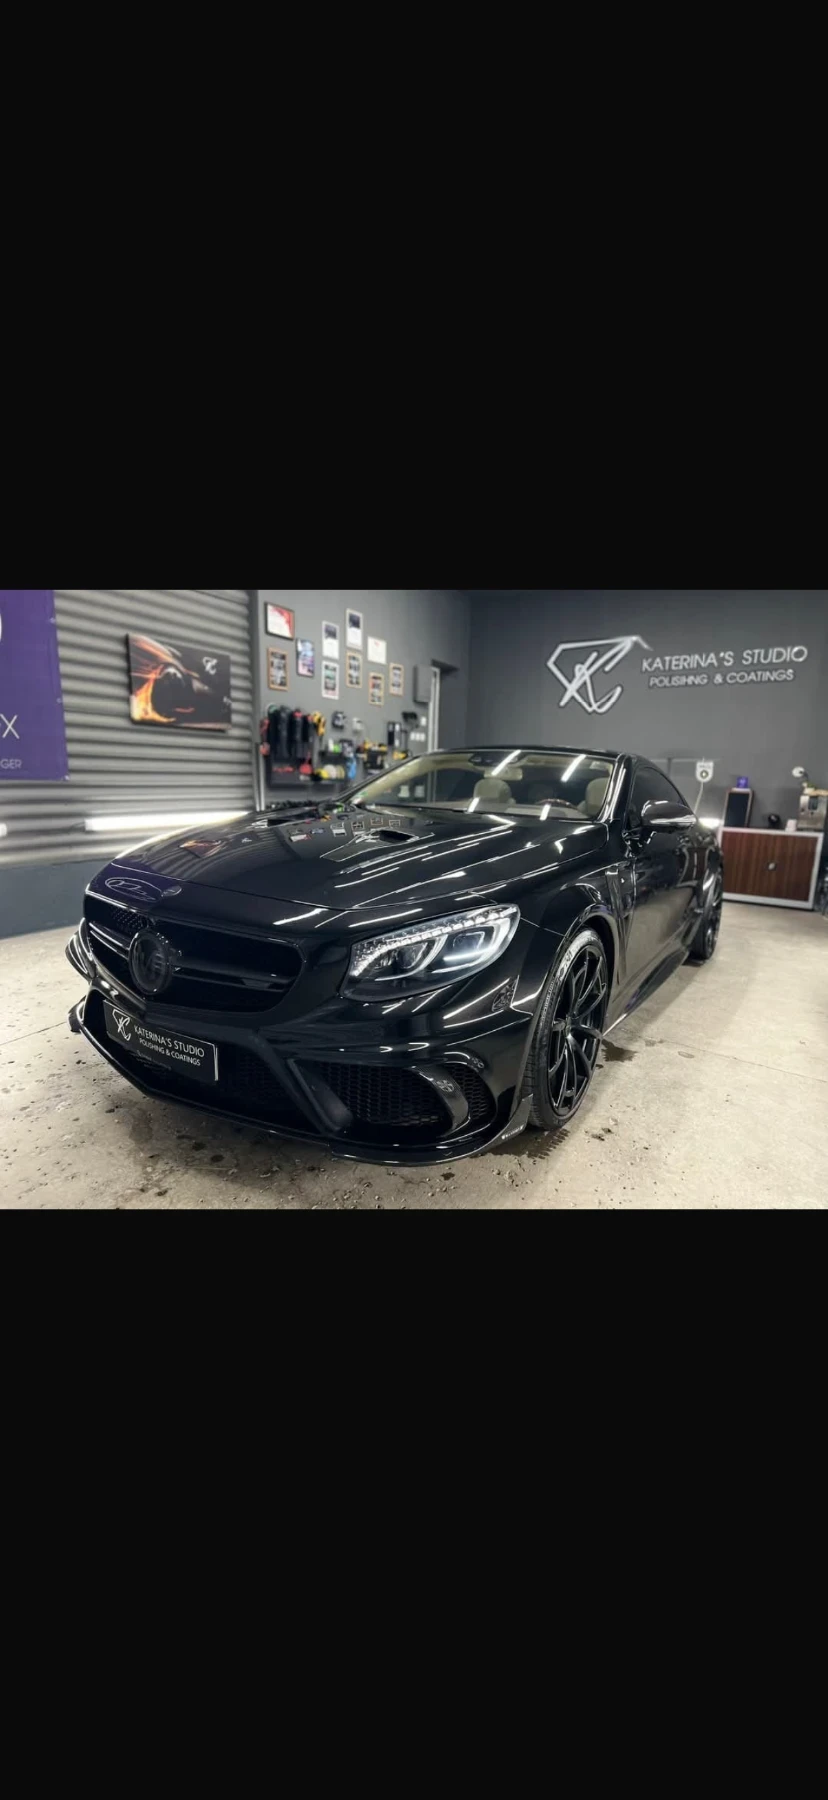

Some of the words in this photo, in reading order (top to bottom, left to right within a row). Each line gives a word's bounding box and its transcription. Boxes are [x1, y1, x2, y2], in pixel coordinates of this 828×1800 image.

[641, 651, 734, 672] KATERINA'S
[741, 645, 808, 665] STUDIO
[713, 674, 723, 685] &
[726, 668, 794, 684] COATINGS
[134, 1024, 172, 1048] KATERINA'S
[173, 1040, 205, 1058] STUDIO
[171, 1051, 201, 1066] COATINGS
